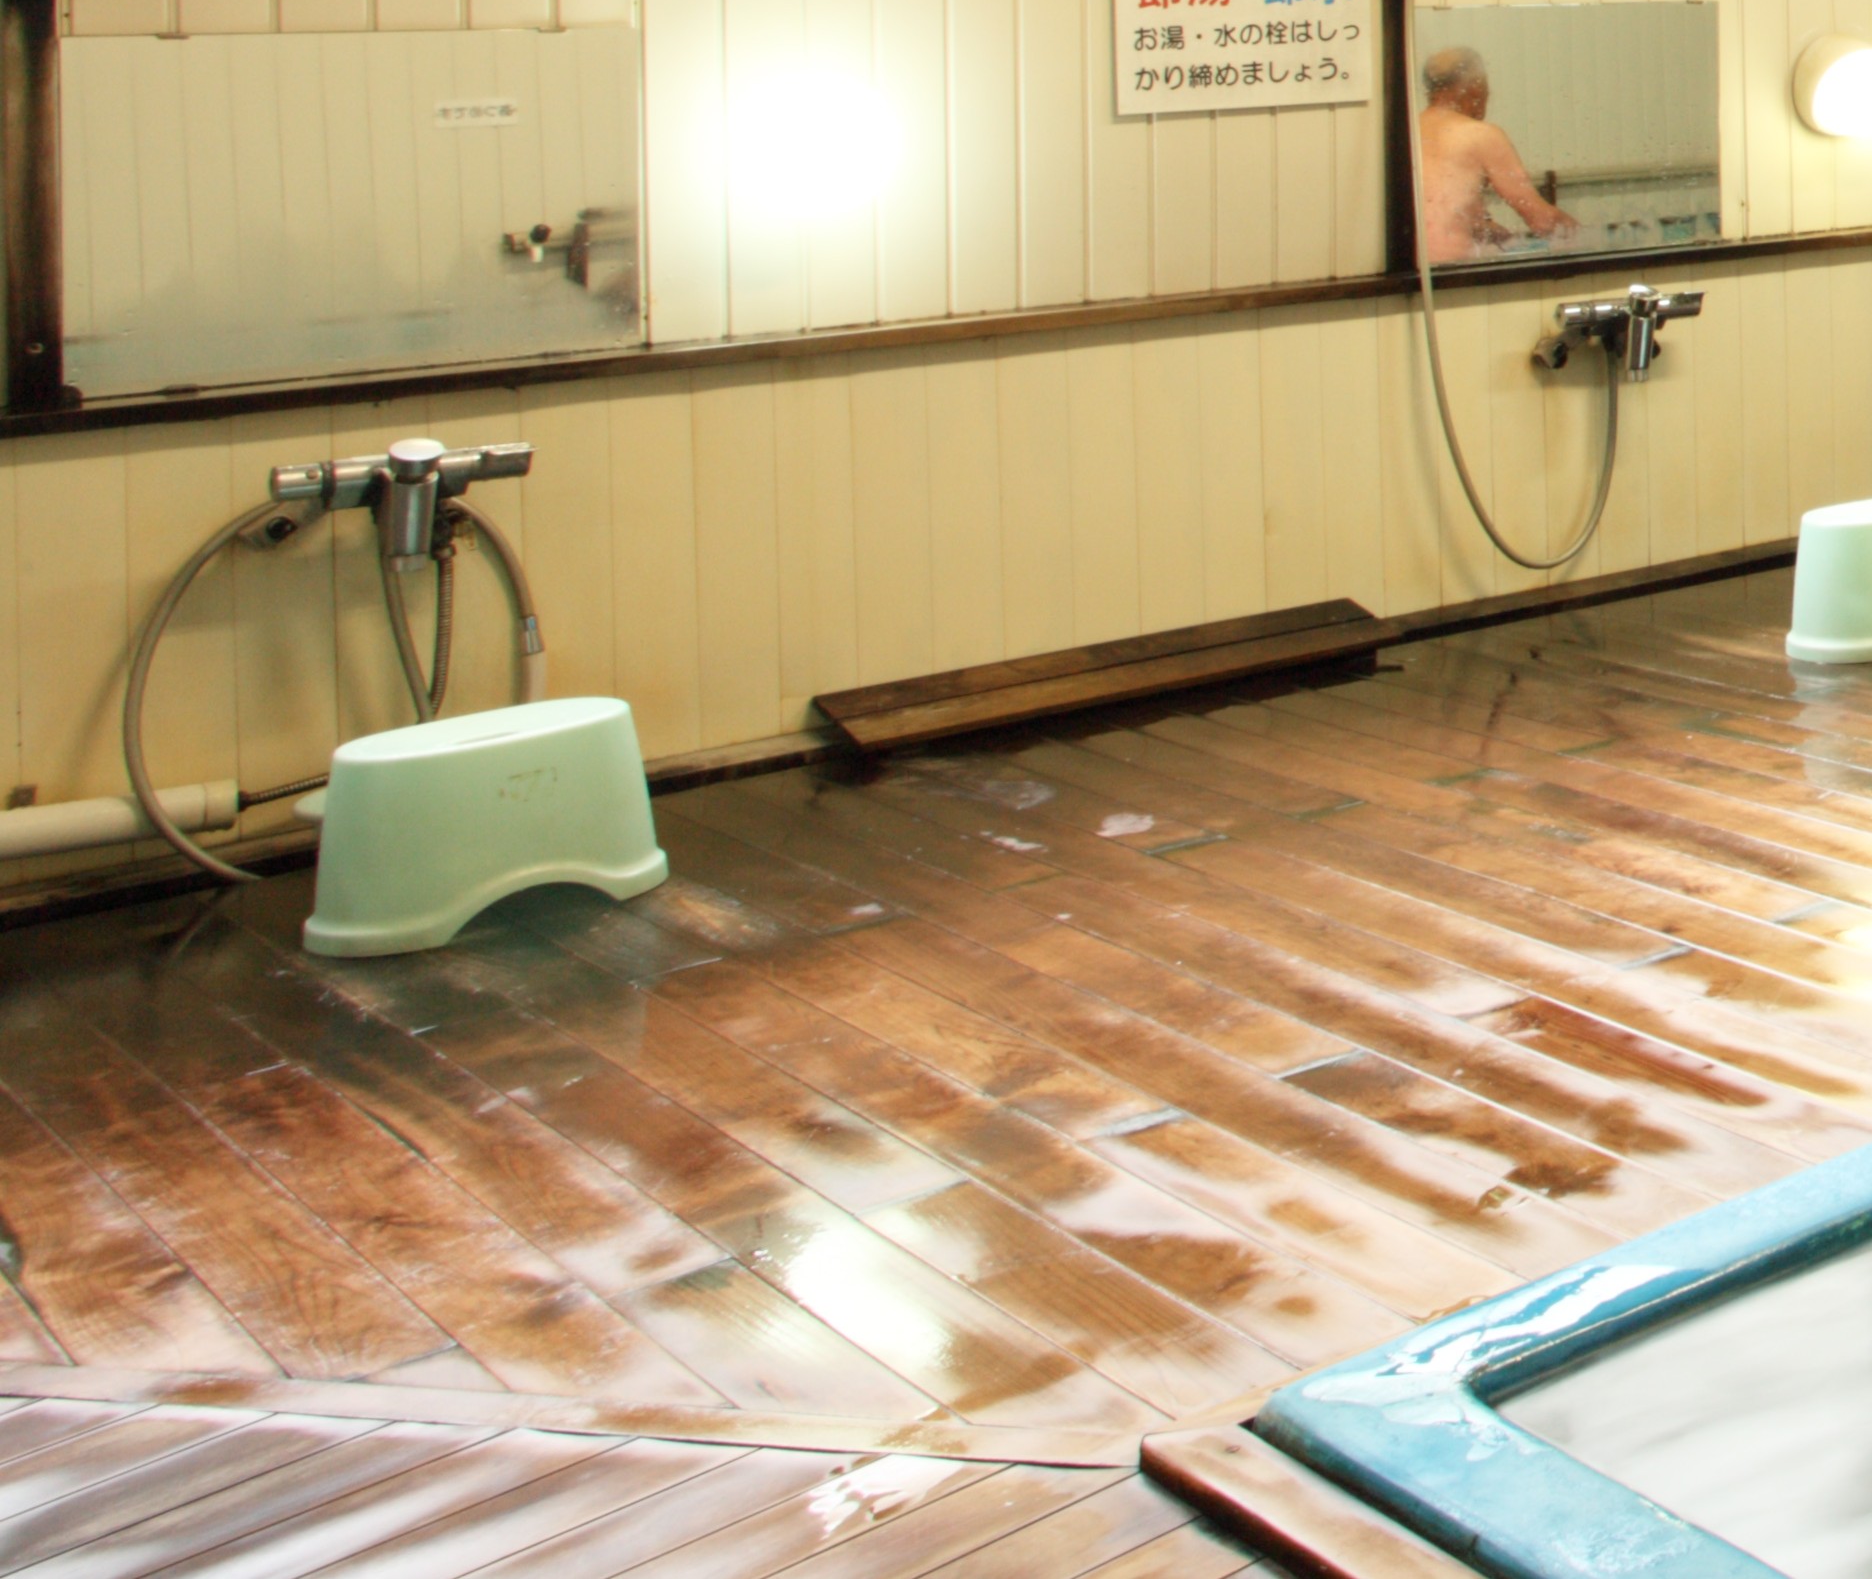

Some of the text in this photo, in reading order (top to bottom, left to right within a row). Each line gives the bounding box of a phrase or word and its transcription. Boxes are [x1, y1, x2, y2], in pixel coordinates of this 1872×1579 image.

[1134, 20, 1360, 51] お湯・水の栓はしっ
[1135, 57, 1350, 91] かり締めましょう。
